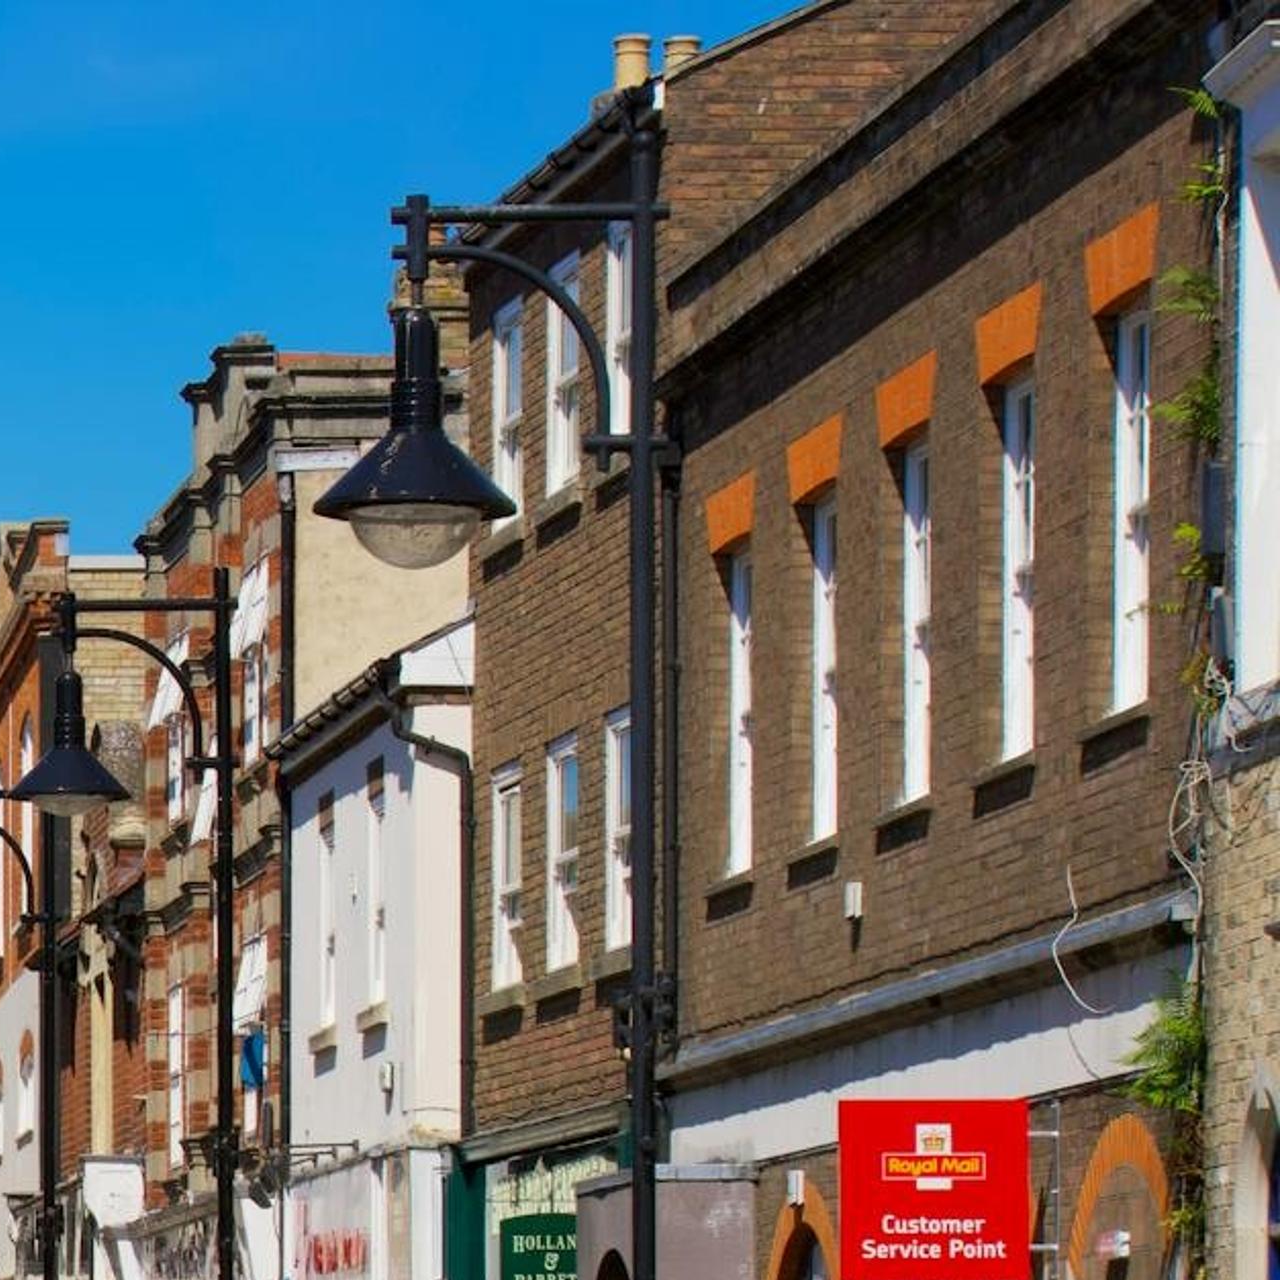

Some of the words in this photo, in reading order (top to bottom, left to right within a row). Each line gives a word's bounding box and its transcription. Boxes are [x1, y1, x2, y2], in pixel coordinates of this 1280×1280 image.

[888, 1158, 938, 1175] Royal
[942, 1157, 980, 1173] Mail
[882, 1214, 986, 1234] Customer
[512, 1234, 577, 1252] HOLLAN
[861, 1239, 941, 1259] Service
[949, 1239, 1006, 1259] Point
[544, 1252, 559, 1270] &
